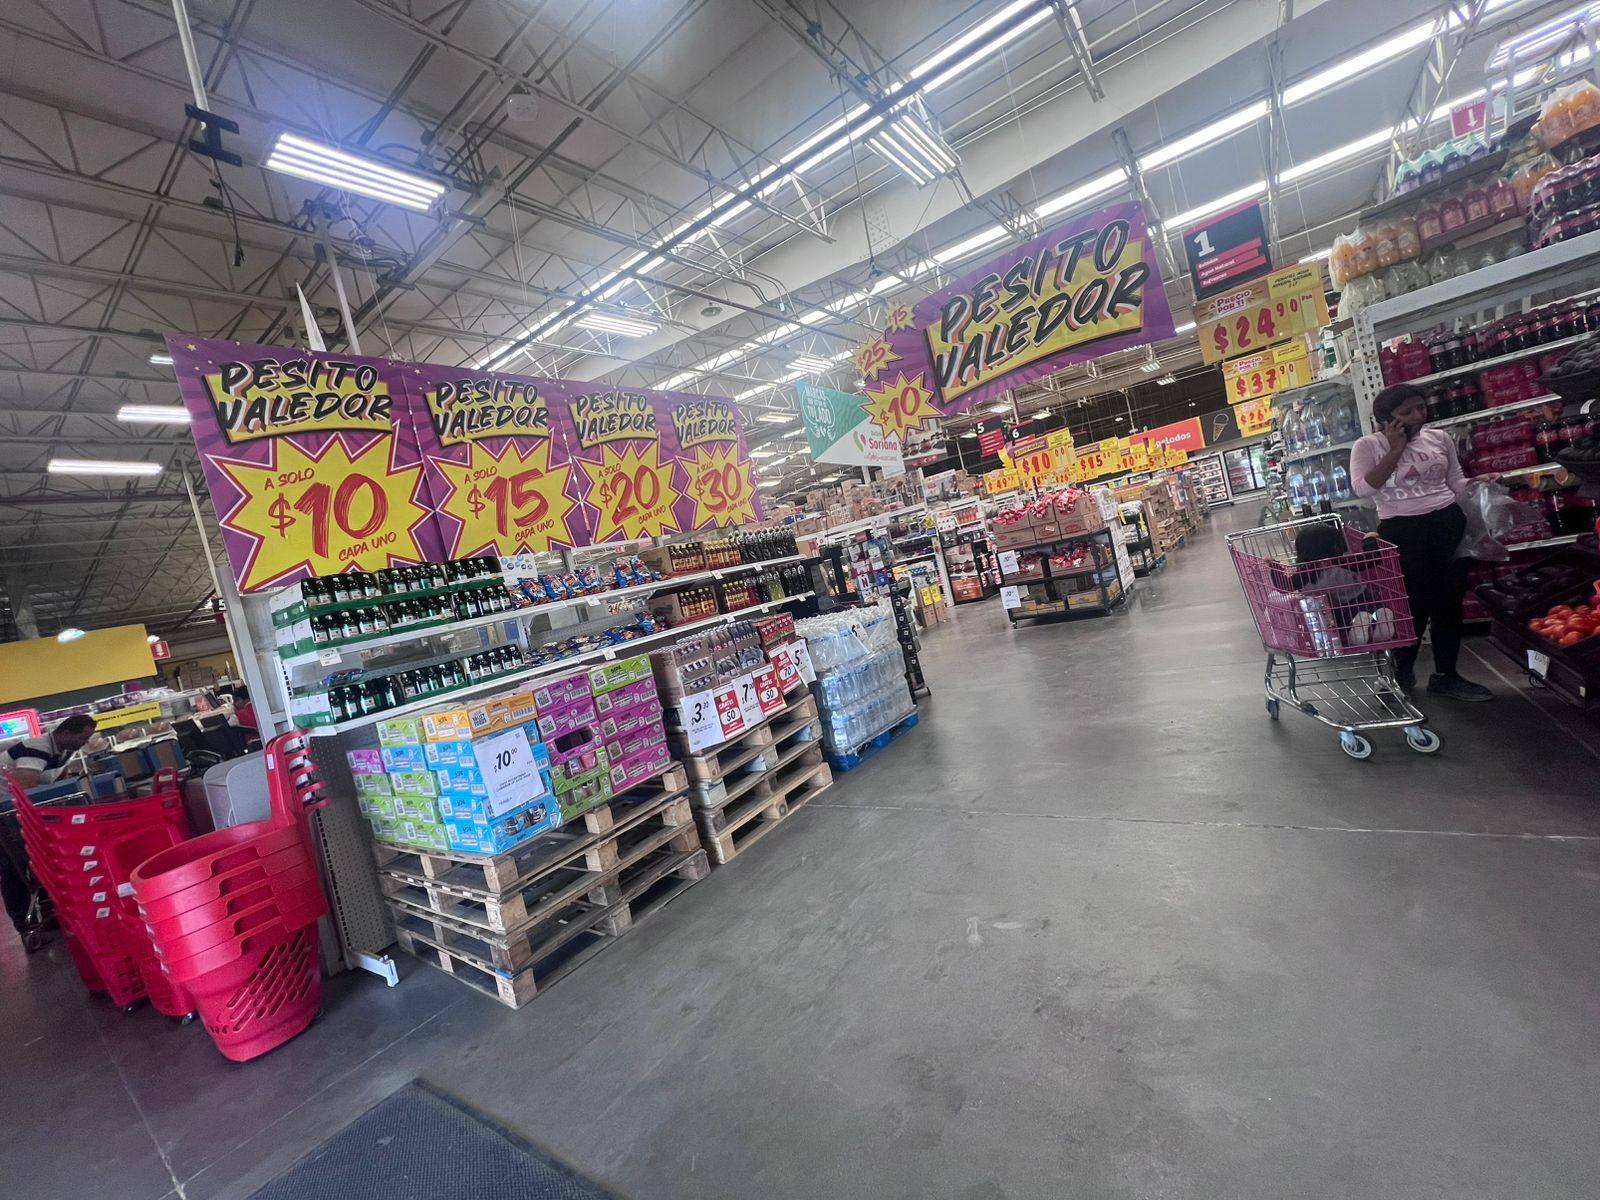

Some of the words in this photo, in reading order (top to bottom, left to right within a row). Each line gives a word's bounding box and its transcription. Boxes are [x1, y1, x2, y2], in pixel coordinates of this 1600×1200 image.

[1194, 231, 1215, 257] 1
[940, 218, 1131, 343] PESITO
[1217, 291, 1251, 307] PRECIO
[1218, 302, 1235, 314] POR
[936, 260, 1151, 389] VALEDOR
[219, 357, 379, 398] PESITO
[435, 378, 539, 409] PESITO
[576, 391, 648, 419] PESITO
[217, 392, 393, 434] VALEDOR
[675, 400, 730, 423] PESITO
[880, 386, 921, 428] $10
[434, 405, 549, 440] VALEDOR
[575, 412, 657, 443] VALEDOR
[676, 418, 737, 444] VALEDOR
[976, 422, 985, 434] 5
[1012, 428, 1020, 438] 6
[868, 438, 897, 451] Soriana
[264, 476, 275, 491] A
[278, 467, 315, 487] SOLO
[464, 473, 471, 484] A
[473, 466, 498, 481] SOLO
[604, 462, 622, 477] SOLO
[701, 461, 714, 472] SOLO
[599, 464, 660, 527] $20
[694, 462, 743, 513] $30
[466, 467, 550, 537] $15
[638, 511, 654, 524] CADA
[654, 504, 667, 519] UNO
[267, 472, 389, 558] $10
[514, 528, 537, 542] CADA
[537, 518, 555, 533] UNO
[338, 542, 369, 562] CADA
[371, 531, 397, 550] UNO
[759, 678, 773, 689] GRATIS
[765, 689, 774, 701] 50
[718, 698, 735, 710] GRATIS
[726, 709, 737, 722] 50
